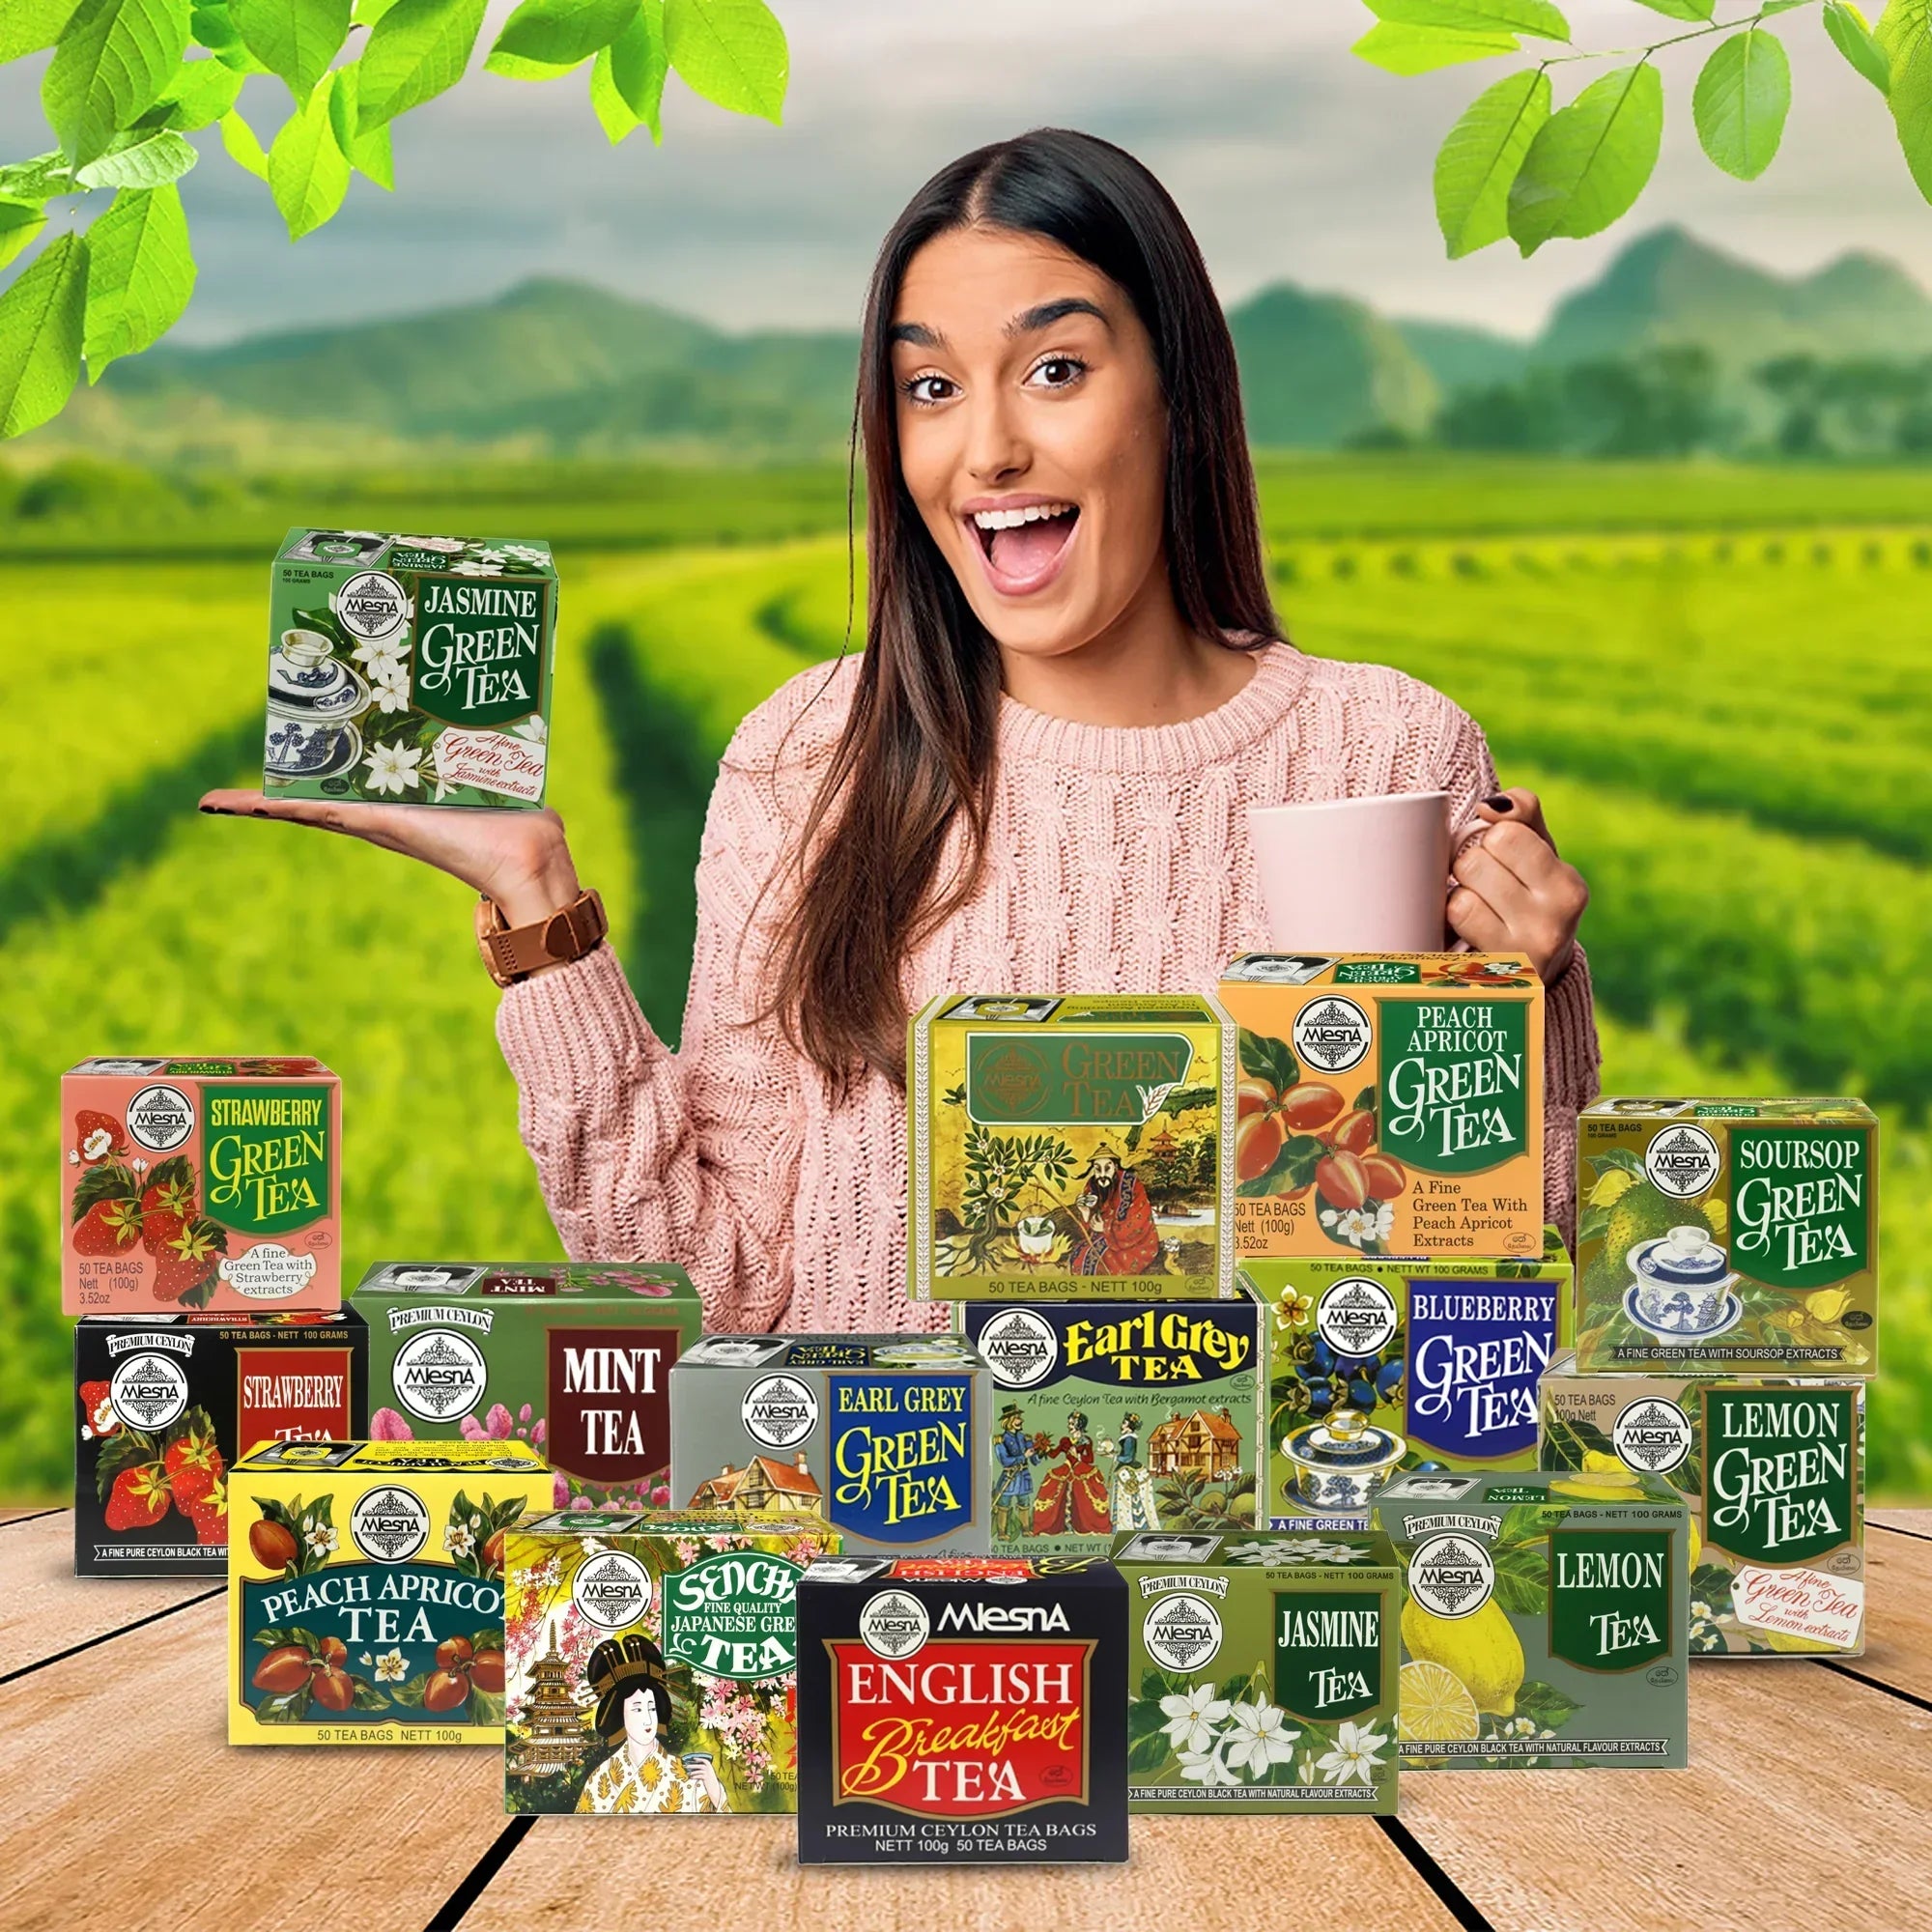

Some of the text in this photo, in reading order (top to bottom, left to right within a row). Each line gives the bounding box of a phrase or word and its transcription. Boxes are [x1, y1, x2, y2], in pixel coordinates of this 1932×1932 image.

[424, 586, 536, 617] JASMINE
[420, 621, 540, 696] GREEN
[455, 666, 530, 710] TEA
[1417, 1007, 1492, 1028] PEACH
[1407, 1031, 1507, 1052] APRICOT
[1389, 1053, 1521, 1142] GREEN
[212, 1099, 322, 1126] STRAWBERRY
[1430, 1102, 1516, 1157] TEA
[1740, 1140, 1859, 1169] SOURSOP
[210, 1130, 325, 1208] GREEN
[245, 1177, 321, 1221] TEA
[1413, 1182, 1461, 1193] A Fine
[1413, 1198, 1527, 1211] Green Tea With
[1736, 1173, 1862, 1256] GREEN
[1413, 1216, 1513, 1232] Peach Apricot
[251, 1248, 286, 1258] A fine
[1413, 1235, 1473, 1246] Extracts
[1775, 1219, 1857, 1271] TEA
[79, 1262, 143, 1274] 50 TEA BAGS
[224, 1260, 312, 1271] Green Tea with
[236, 1273, 302, 1285] Strawberry
[1434, 1265, 1448, 1274] 100
[1451, 1266, 1488, 1275] GRAMS
[79, 1277, 139, 1291] Nett (100g)
[243, 1285, 293, 1294] extracts
[989, 1282, 1162, 1294] 50 TEA BAGS NETT 100g
[79, 1293, 110, 1304] 3.52oz
[1413, 1295, 1555, 1322] BLUEBERRY
[392, 1309, 490, 1329] PREMIUM CEYLON
[110, 1335, 191, 1352] PREMIUM CEYLON
[1063, 1310, 1249, 1370] Earl Grey
[1651, 1349, 1686, 1358] GREEN
[1689, 1349, 1706, 1358] TEA
[1708, 1349, 1733, 1358] WITH
[1736, 1349, 1783, 1358] SOURSOP
[1786, 1349, 1837, 1358] EXTRACTS
[563, 1349, 661, 1394] MINT
[1112, 1355, 1202, 1380] TEA
[1414, 1331, 1553, 1422] GREEN
[243, 1376, 343, 1409] STRAWBERRY
[838, 1387, 965, 1412] EARL GREY
[1037, 1395, 1060, 1405] fine
[1064, 1395, 1100, 1406] Ceylon
[1102, 1394, 1122, 1405] Tea
[1125, 1395, 1149, 1405] with
[1151, 1394, 1206, 1406] Bergamot
[1208, 1394, 1252, 1405] extracts
[1555, 1395, 1615, 1406] 50 TEA BAGS
[581, 1410, 645, 1455] TEA
[1722, 1403, 1839, 1437] LEMON
[836, 1422, 966, 1509] GREEN
[876, 1471, 961, 1524] TEA
[1713, 1442, 1847, 1533] GREEN
[1408, 1518, 1497, 1535] PREMIUM CEYLON
[1754, 1492, 1841, 1548] TEA
[1557, 1552, 1664, 1589] LEMON
[262, 1575, 369, 1623] PEACH
[1143, 1577, 1225, 1594] PREMIUM CEYLON
[704, 1603, 781, 1614] FINE QUALITY
[338, 1606, 438, 1643] TEA
[671, 1616, 755, 1633] JAPANESE
[1278, 1611, 1378, 1648] JASMINE
[1590, 1611, 1661, 1656] TEA
[700, 1634, 796, 1672] TEA
[847, 1663, 1072, 1705] ENGLISH
[1309, 1667, 1373, 1708] TEA
[318, 1730, 462, 1743] 50 TEA BAGS NETT 100g
[1406, 1742, 1660, 1754] FINE PURE CEYLON BLACK TEA WITH NATURAL FLAVOUR EXTRACTS
[842, 1707, 1080, 1796] Breakfast
[913, 1760, 1026, 1802] TEA
[826, 1824, 1096, 1836] PREMIUM CEYLON TEA BAGS
[876, 1839, 1046, 1854] NETT 100g 50 TEA BAGS
